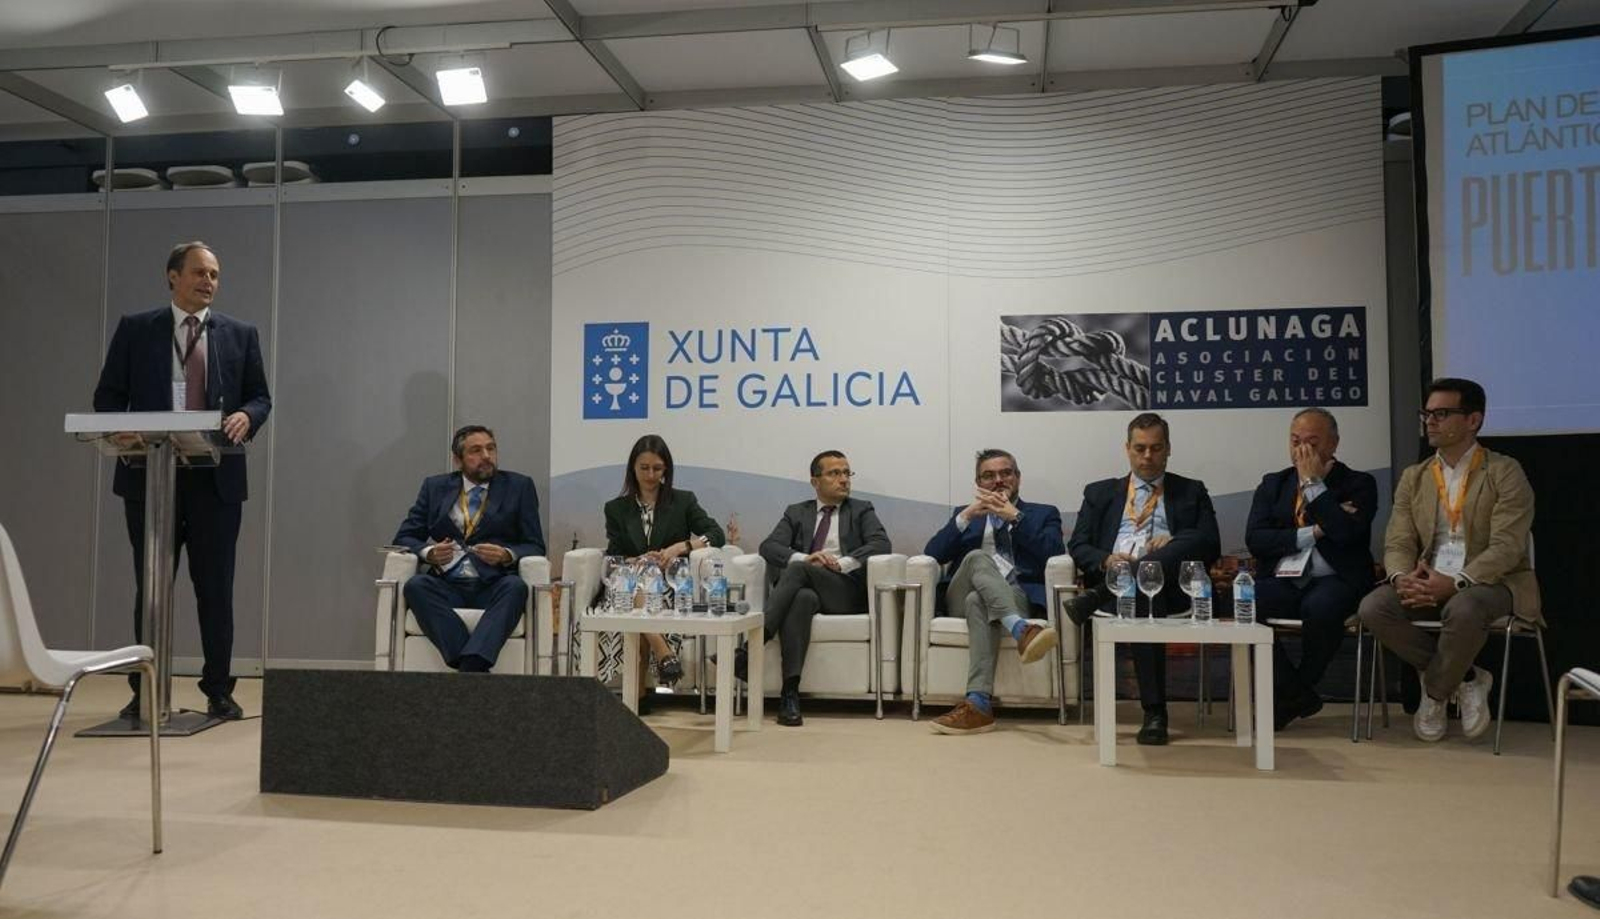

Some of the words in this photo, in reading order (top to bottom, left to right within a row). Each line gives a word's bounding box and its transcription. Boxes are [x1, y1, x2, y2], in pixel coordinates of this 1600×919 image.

[1466, 96, 1547, 128] PLAN
[1154, 313, 1361, 342] ACLUNAGA
[667, 327, 820, 364] XUNTA
[1155, 345, 1359, 365] ASOCIACIÓN
[665, 375, 720, 409] DE
[736, 371, 921, 409] GALICIA
[1155, 369, 1285, 385] CLUSTER
[1308, 367, 1357, 382] DEL
[1156, 389, 1233, 403] NAVAL
[1250, 386, 1362, 402] GALLEGO
